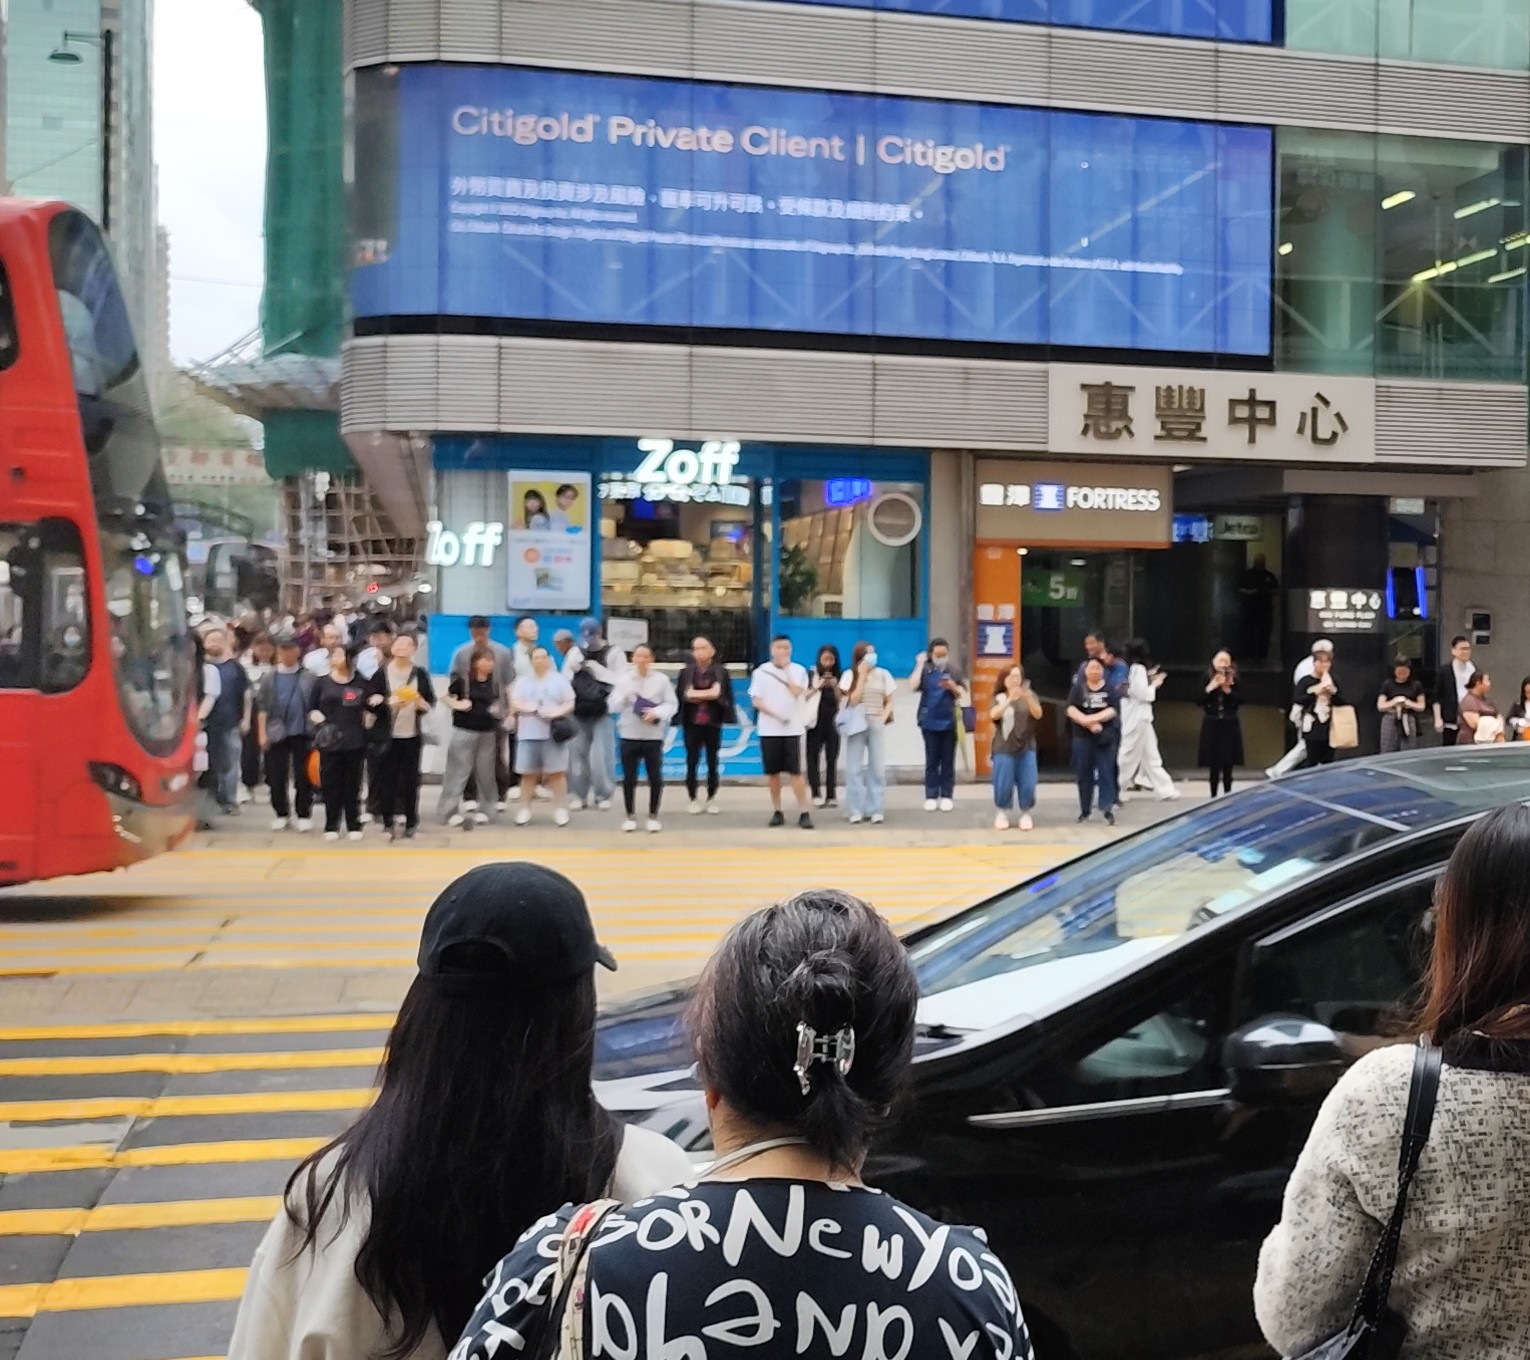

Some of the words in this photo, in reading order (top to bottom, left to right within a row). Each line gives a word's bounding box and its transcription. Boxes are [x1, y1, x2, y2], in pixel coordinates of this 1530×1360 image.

[607, 115, 734, 154] Private
[740, 125, 846, 161] Client
[1080, 380, 1349, 447] 惠豐中心
[634, 438, 741, 485] Zoff
[1066, 485, 1161, 511] FORTRESS
